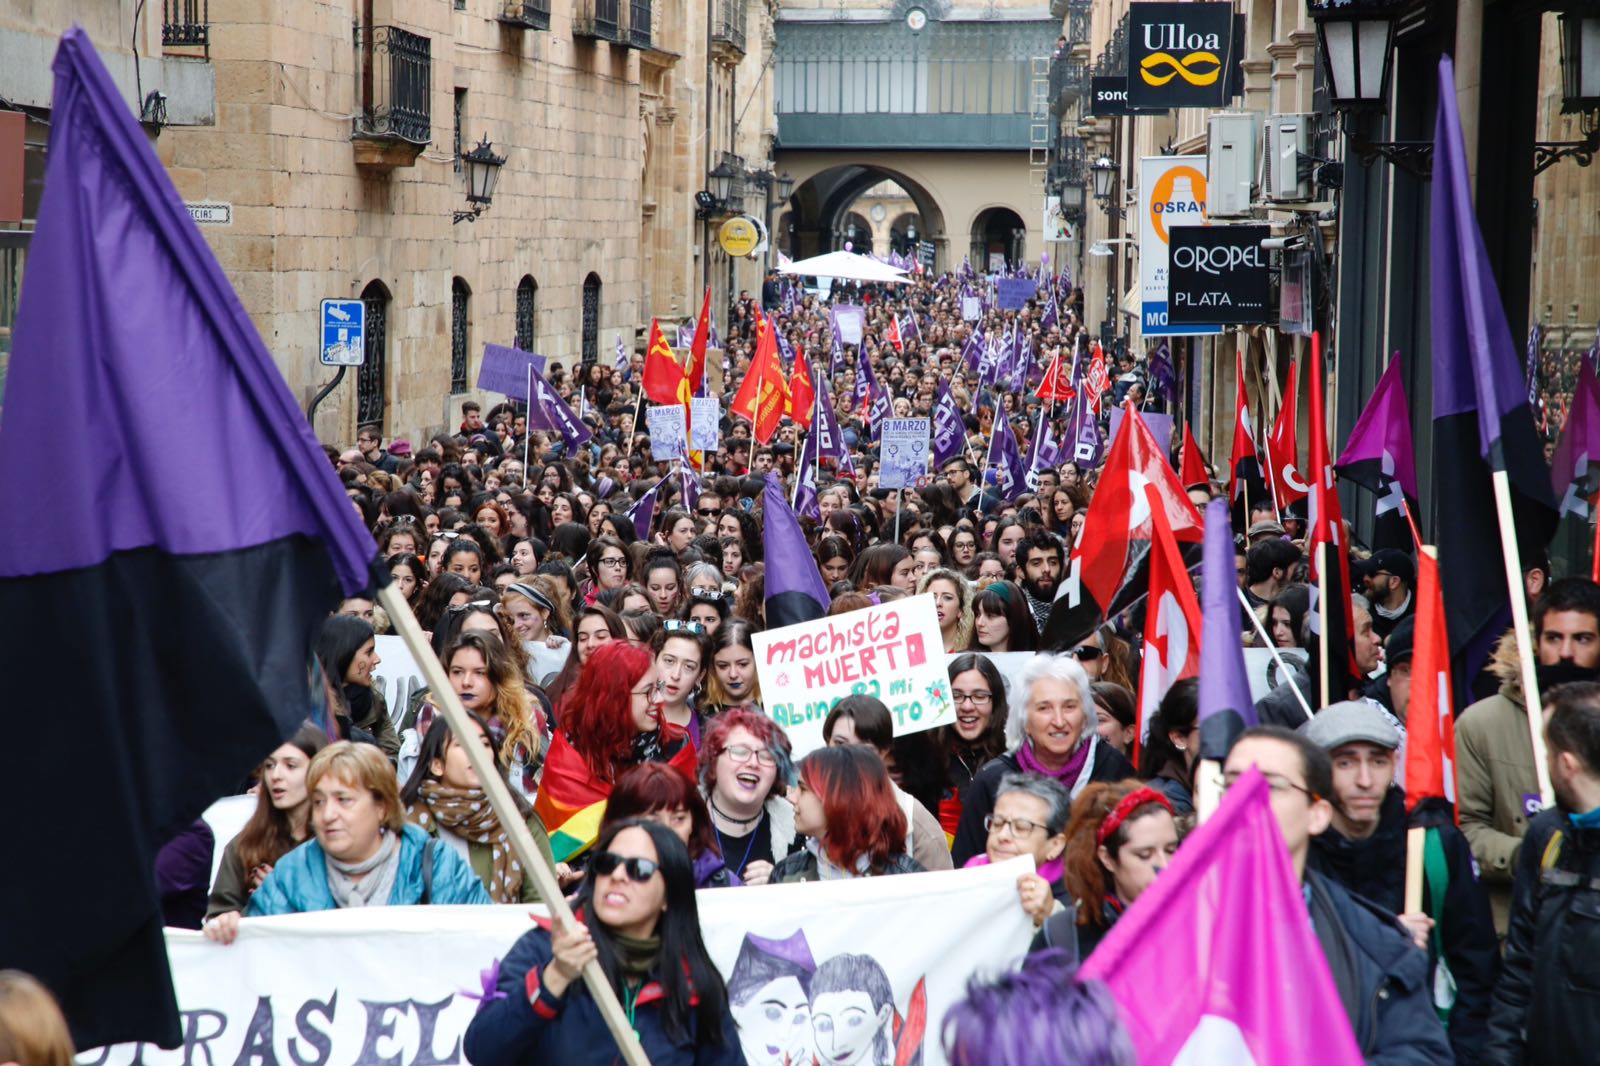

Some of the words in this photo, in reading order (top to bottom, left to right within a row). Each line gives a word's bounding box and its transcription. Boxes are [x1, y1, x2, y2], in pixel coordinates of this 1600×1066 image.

[1142, 23, 1221, 50] Ulloa
[1173, 246, 1266, 275] OROPEL
[1175, 292, 1232, 306] PLATA
[655, 406, 680, 417] MARZO
[883, 421, 890, 431] 8
[893, 420, 927, 431] MARZO
[766, 611, 900, 665] machista
